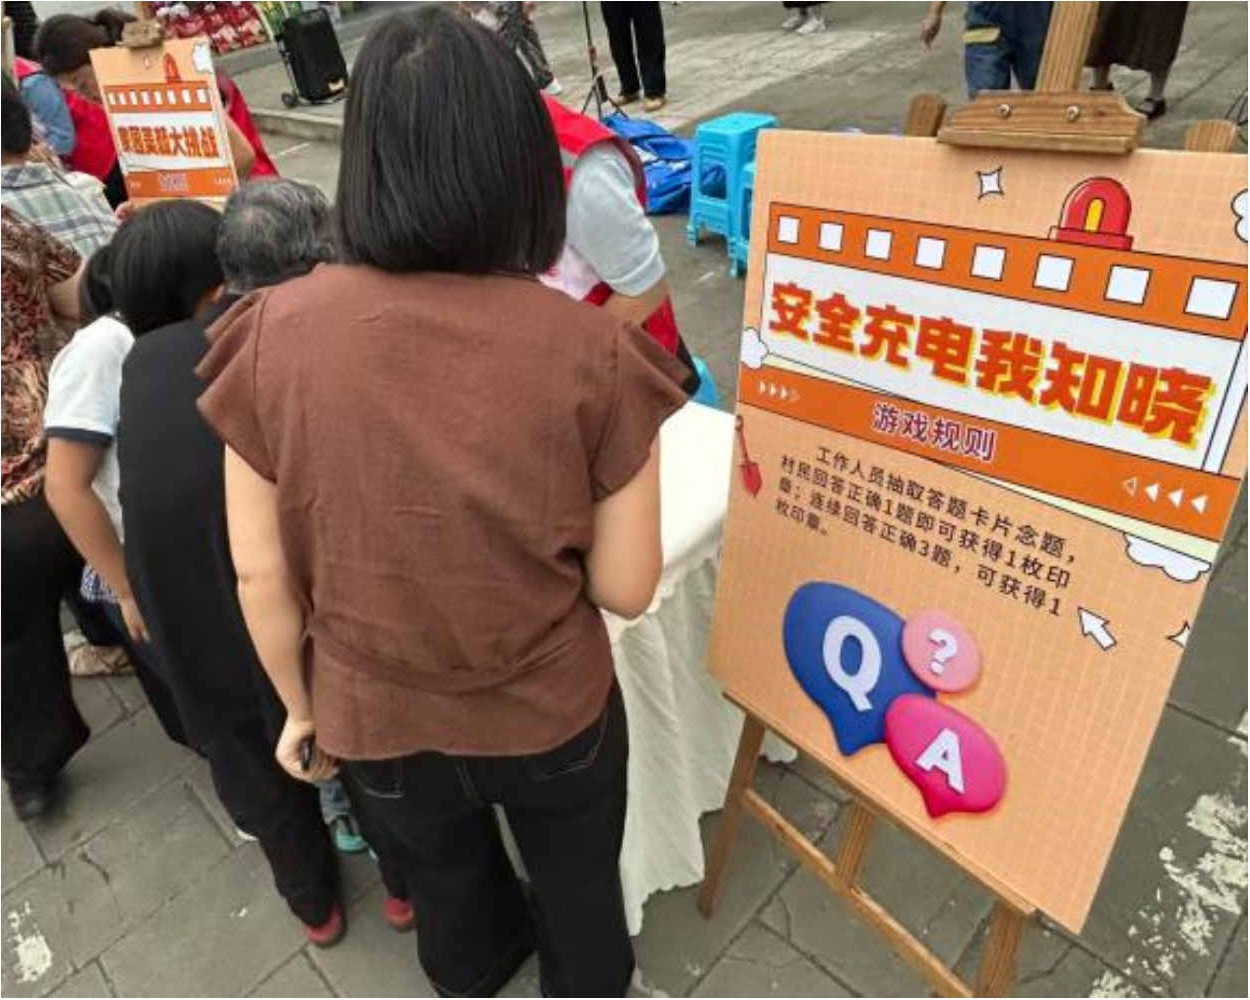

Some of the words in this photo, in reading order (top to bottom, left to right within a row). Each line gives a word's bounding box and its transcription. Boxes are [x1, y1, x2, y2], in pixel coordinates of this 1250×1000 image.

[767, 279, 1217, 450] 安全充电我知晓
[871, 402, 998, 462] 游戏规则
[778, 477, 1061, 617] 章；连续回答正确3题，可获得1
[780, 454, 1071, 589] 村民回答正确1题即可获得1枚印
[816, 445, 1077, 564] 工作人员抽取答题卡片念题，
[822, 615, 884, 711] Q
[926, 628, 958, 675] ?
[915, 727, 968, 795] A
